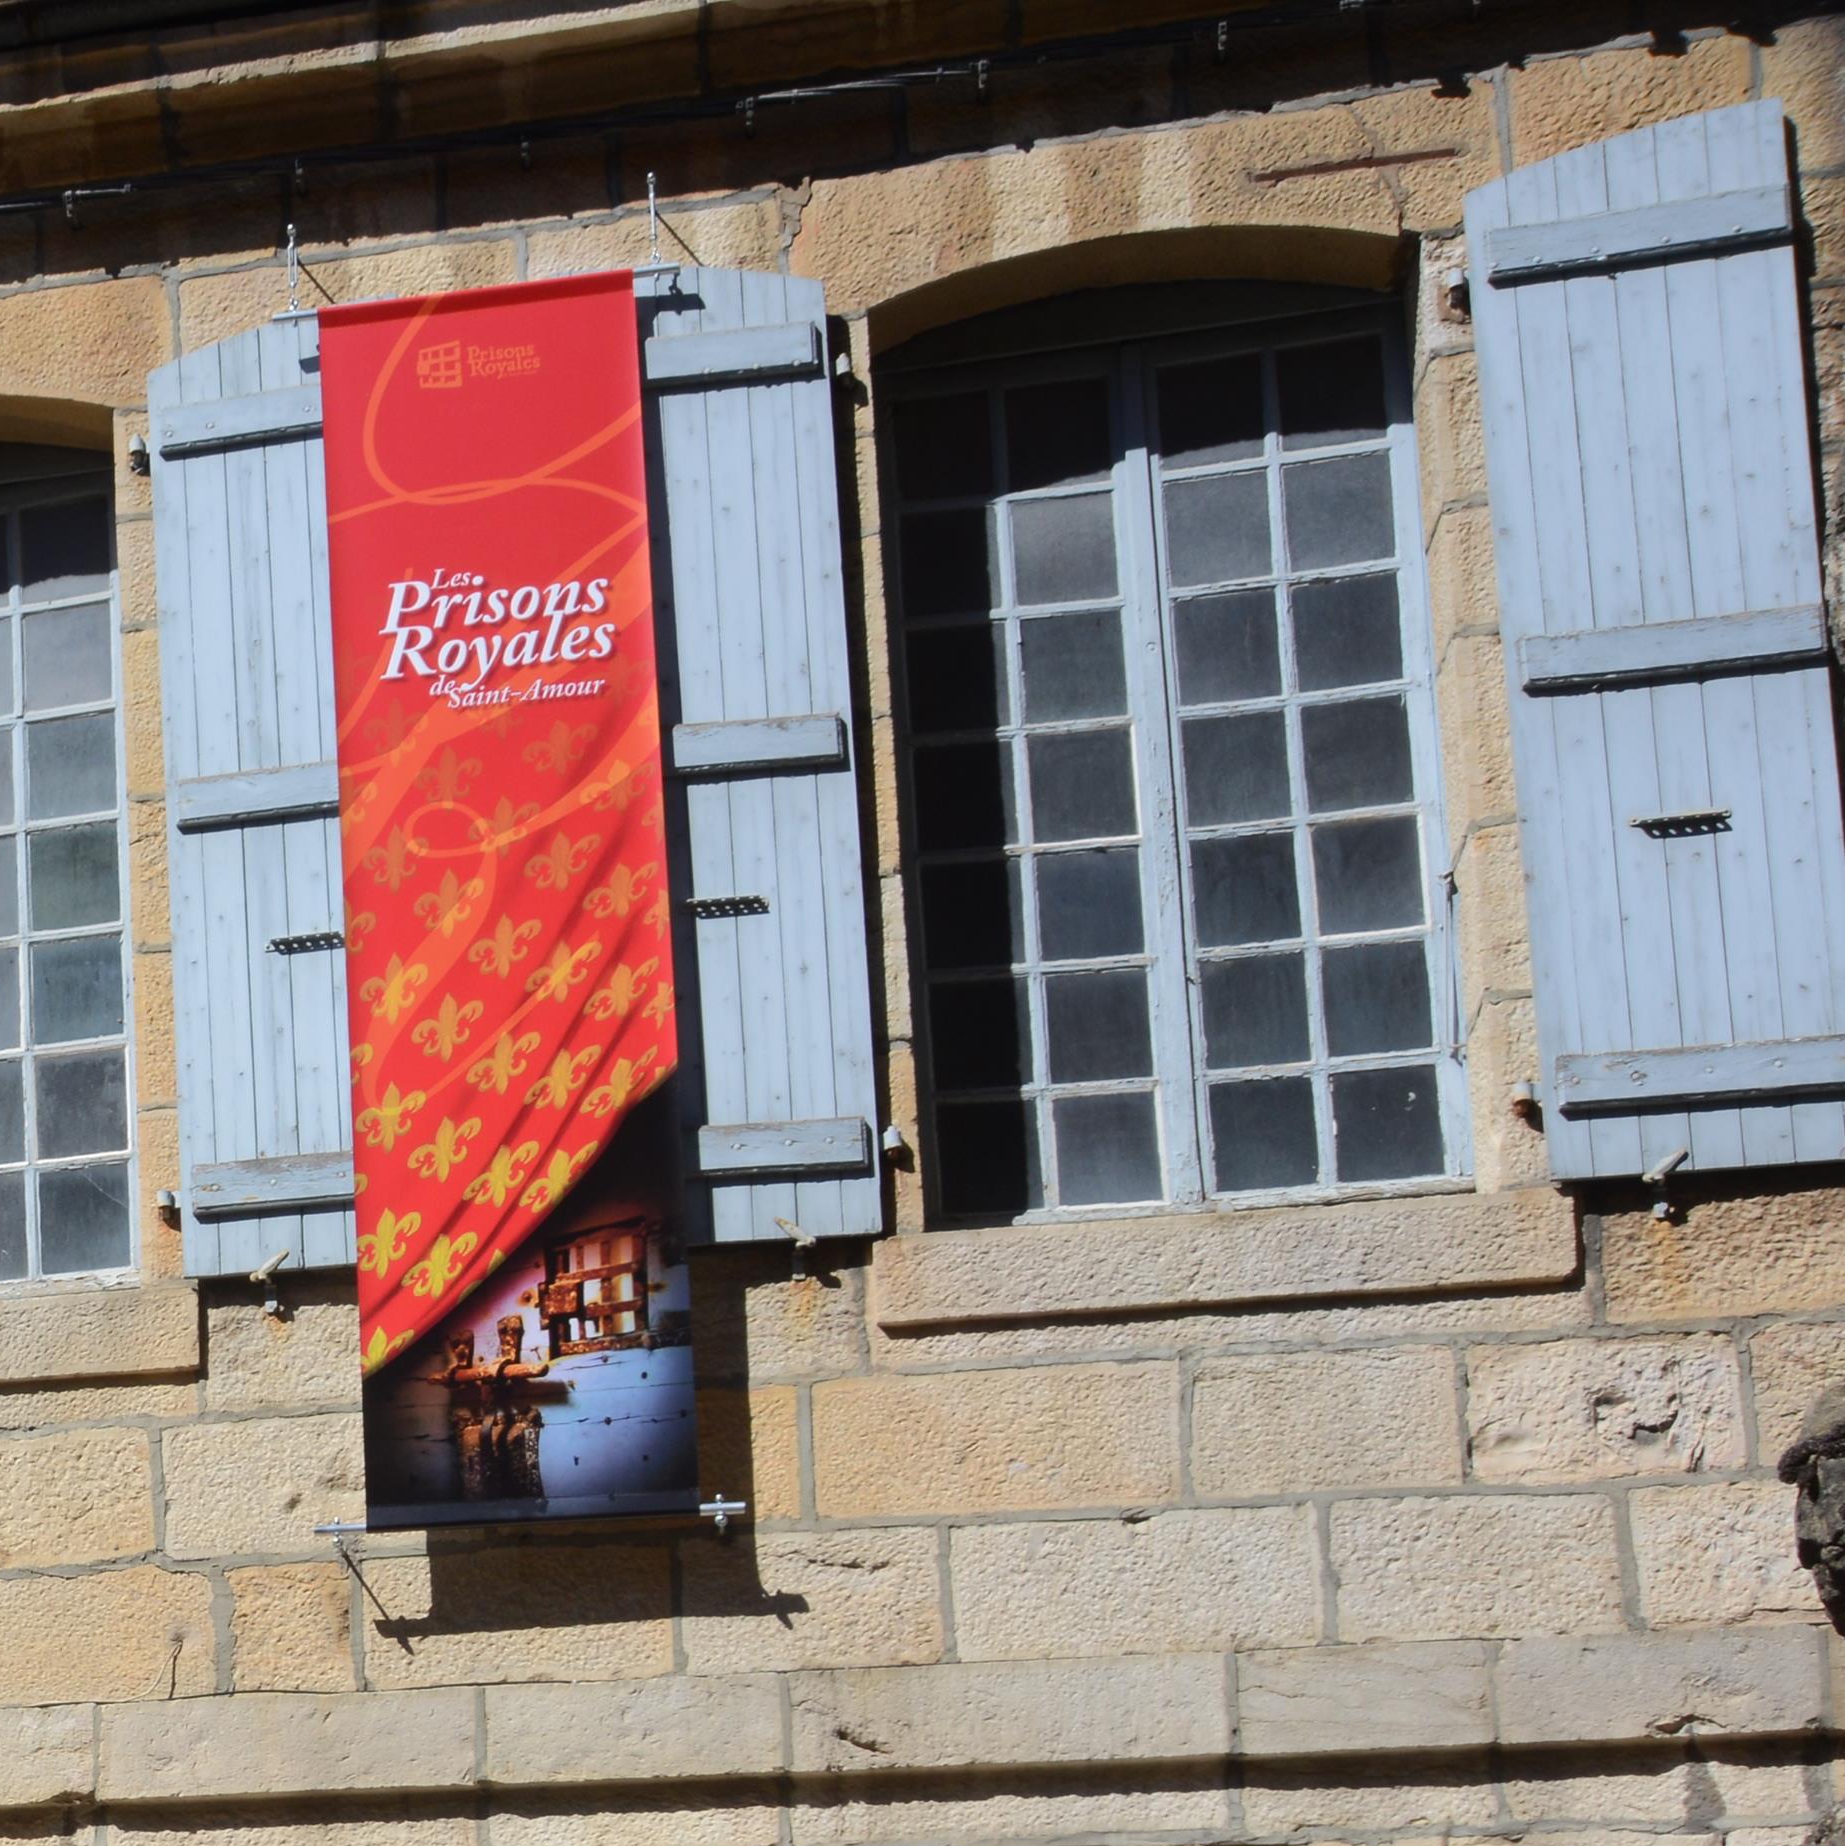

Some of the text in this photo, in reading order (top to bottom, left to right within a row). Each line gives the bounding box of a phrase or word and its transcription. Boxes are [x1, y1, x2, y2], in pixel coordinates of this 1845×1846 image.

[467, 344, 535, 363] Prisons
[469, 355, 541, 379] Royales
[431, 568, 470, 589] Les
[378, 575, 608, 634] Prisons
[380, 610, 615, 691] Royales
[429, 674, 605, 708] de Saint-Amour
